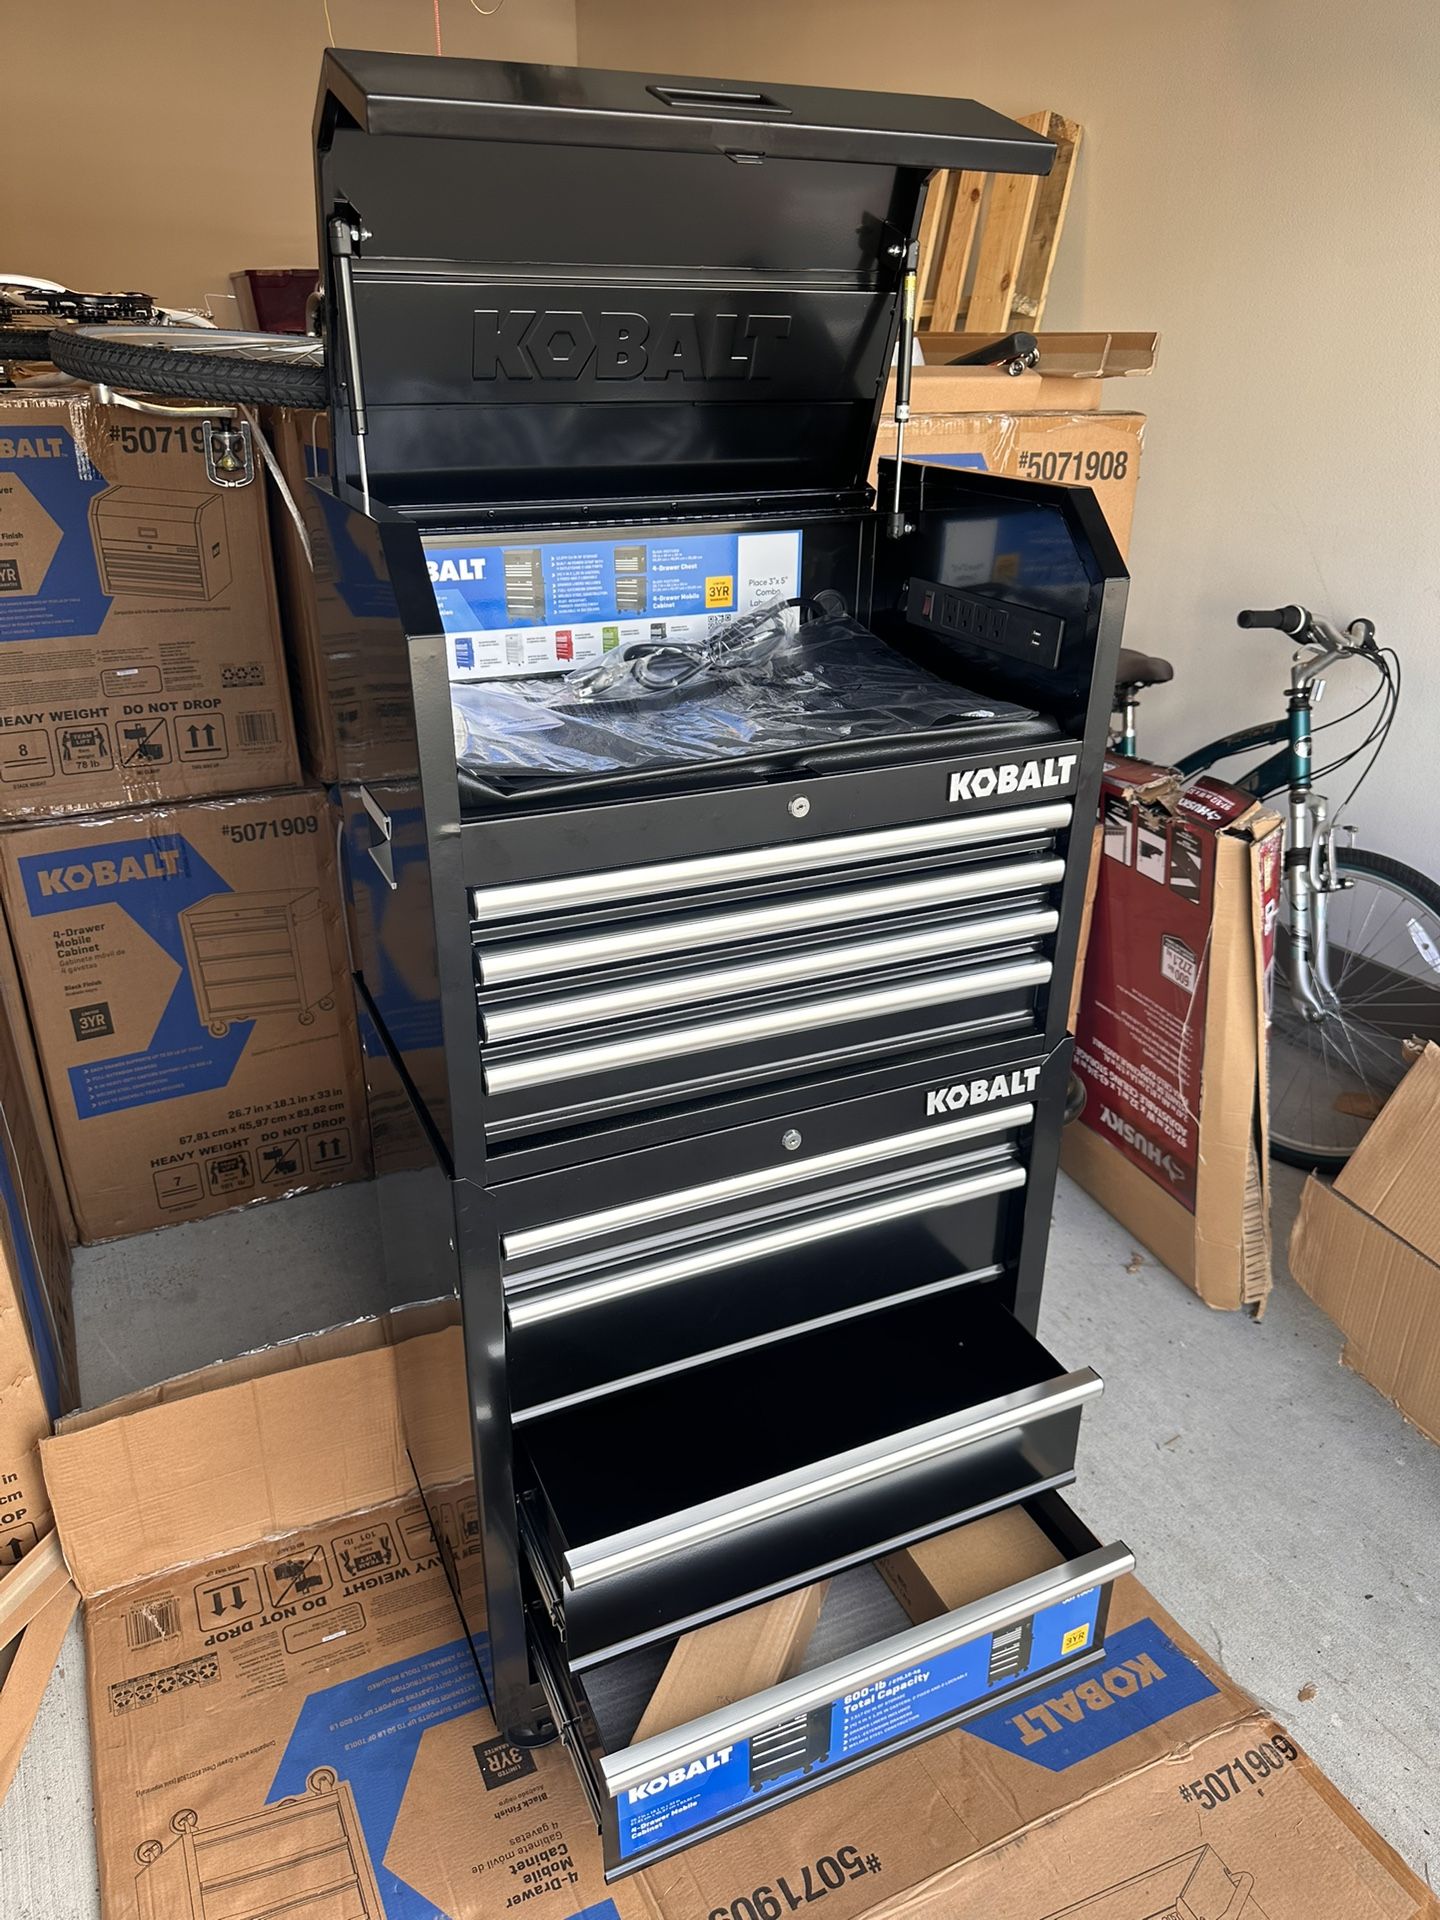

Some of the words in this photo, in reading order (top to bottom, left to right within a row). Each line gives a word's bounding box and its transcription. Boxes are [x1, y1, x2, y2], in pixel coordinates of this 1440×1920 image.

[472, 310, 791, 381] KOBALT
[110, 425, 242, 454] #50719
[1019, 451, 1128, 481] #5071908
[652, 564, 680, 572] 4-Drawer
[749, 578, 767, 587] Place
[652, 594, 680, 602] 4-Drawer
[709, 586, 730, 597] 3YR
[49, 706, 110, 721] WEIGHT
[123, 704, 144, 715] DO
[148, 701, 179, 713] NOT
[183, 698, 222, 710] DROP
[18, 744, 29, 757] 8
[76, 761, 88, 769] 78
[90, 760, 100, 768] lb
[949, 754, 1078, 802] KOBALT
[221, 815, 318, 844] #5071909
[37, 849, 180, 896] KOBALT
[53, 923, 105, 939] 4-Drawer
[54, 936, 91, 949] Mobile
[57, 944, 100, 959] Cabinet
[58, 954, 93, 967] Gabinete
[1174, 969, 1189, 987] 600
[79, 1013, 106, 1029] 3YR
[926, 1066, 1041, 1117] KOBALT
[227, 1106, 252, 1120] 26.7
[252, 1104, 264, 1114] in
[265, 1103, 273, 1111] x
[274, 1096, 297, 1109] 18.1
[297, 1095, 309, 1105] in
[317, 1089, 331, 1100] 33
[332, 1087, 343, 1097] in
[211, 1127, 229, 1137] cm
[230, 1126, 238, 1134] x
[271, 1114, 287, 1124] cm
[328, 1103, 345, 1112] cm
[261, 1130, 279, 1142] DO
[283, 1124, 309, 1137] NOT
[312, 1116, 346, 1130] DROP
[1099, 1106, 1162, 1163] HUSKY
[151, 1150, 195, 1168] HEAVY
[199, 1137, 250, 1156] WEIGHT
[173, 1176, 182, 1186] 7
[1, 1473, 18, 1485] in
[343, 1537, 354, 1547] lb
[360, 1531, 376, 1541] 101
[342, 1565, 410, 1598] WEIGHT
[302, 1596, 327, 1611] DO
[259, 1606, 297, 1627] NOT
[204, 1620, 254, 1647] DROP
[1066, 1631, 1085, 1646] 3YR
[400, 1666, 421, 1680] TOOLS
[367, 1673, 400, 1692] REQUIRED
[390, 1672, 439, 1695] CONSTRUCTION
[843, 1694, 876, 1714] Total
[877, 1671, 931, 1701] Capacity
[843, 1680, 887, 1705] 600-lb
[1011, 1653, 1167, 1746] KOBALT
[363, 1709, 374, 1718] UP
[374, 1697, 404, 1714] SUPPORT
[353, 1713, 363, 1722] TO
[407, 1718, 417, 1727] UP
[377, 1729, 386, 1738] LB
[397, 1722, 407, 1731] TO
[344, 1736, 366, 1751] TOOLS
[367, 1733, 377, 1741] OF
[239, 1750, 250, 1759] with
[249, 1740, 276, 1755] Compatible
[201, 1763, 216, 1774] Chest
[486, 1748, 522, 1773] 3YR
[497, 1763, 521, 1778] LIMITED
[628, 1745, 734, 1805] KOBALT
[1179, 1734, 1298, 1811] #5071909
[523, 1791, 548, 1808] Black
[494, 1801, 523, 1820] Finish
[630, 1812, 671, 1834] 4-Drawer
[671, 1800, 698, 1817] Mobile
[508, 1823, 549, 1846] gavetas
[551, 1821, 559, 1831] 4
[630, 1821, 664, 1840] Cabinet
[517, 1830, 563, 1856] Gabinete
[487, 1849, 514, 1869] móvil
[509, 1843, 569, 1877] Cabinet
[471, 1864, 484, 1876] de
[522, 1856, 574, 1886] Mobile
[506, 1871, 579, 1909] 4-Drawer
